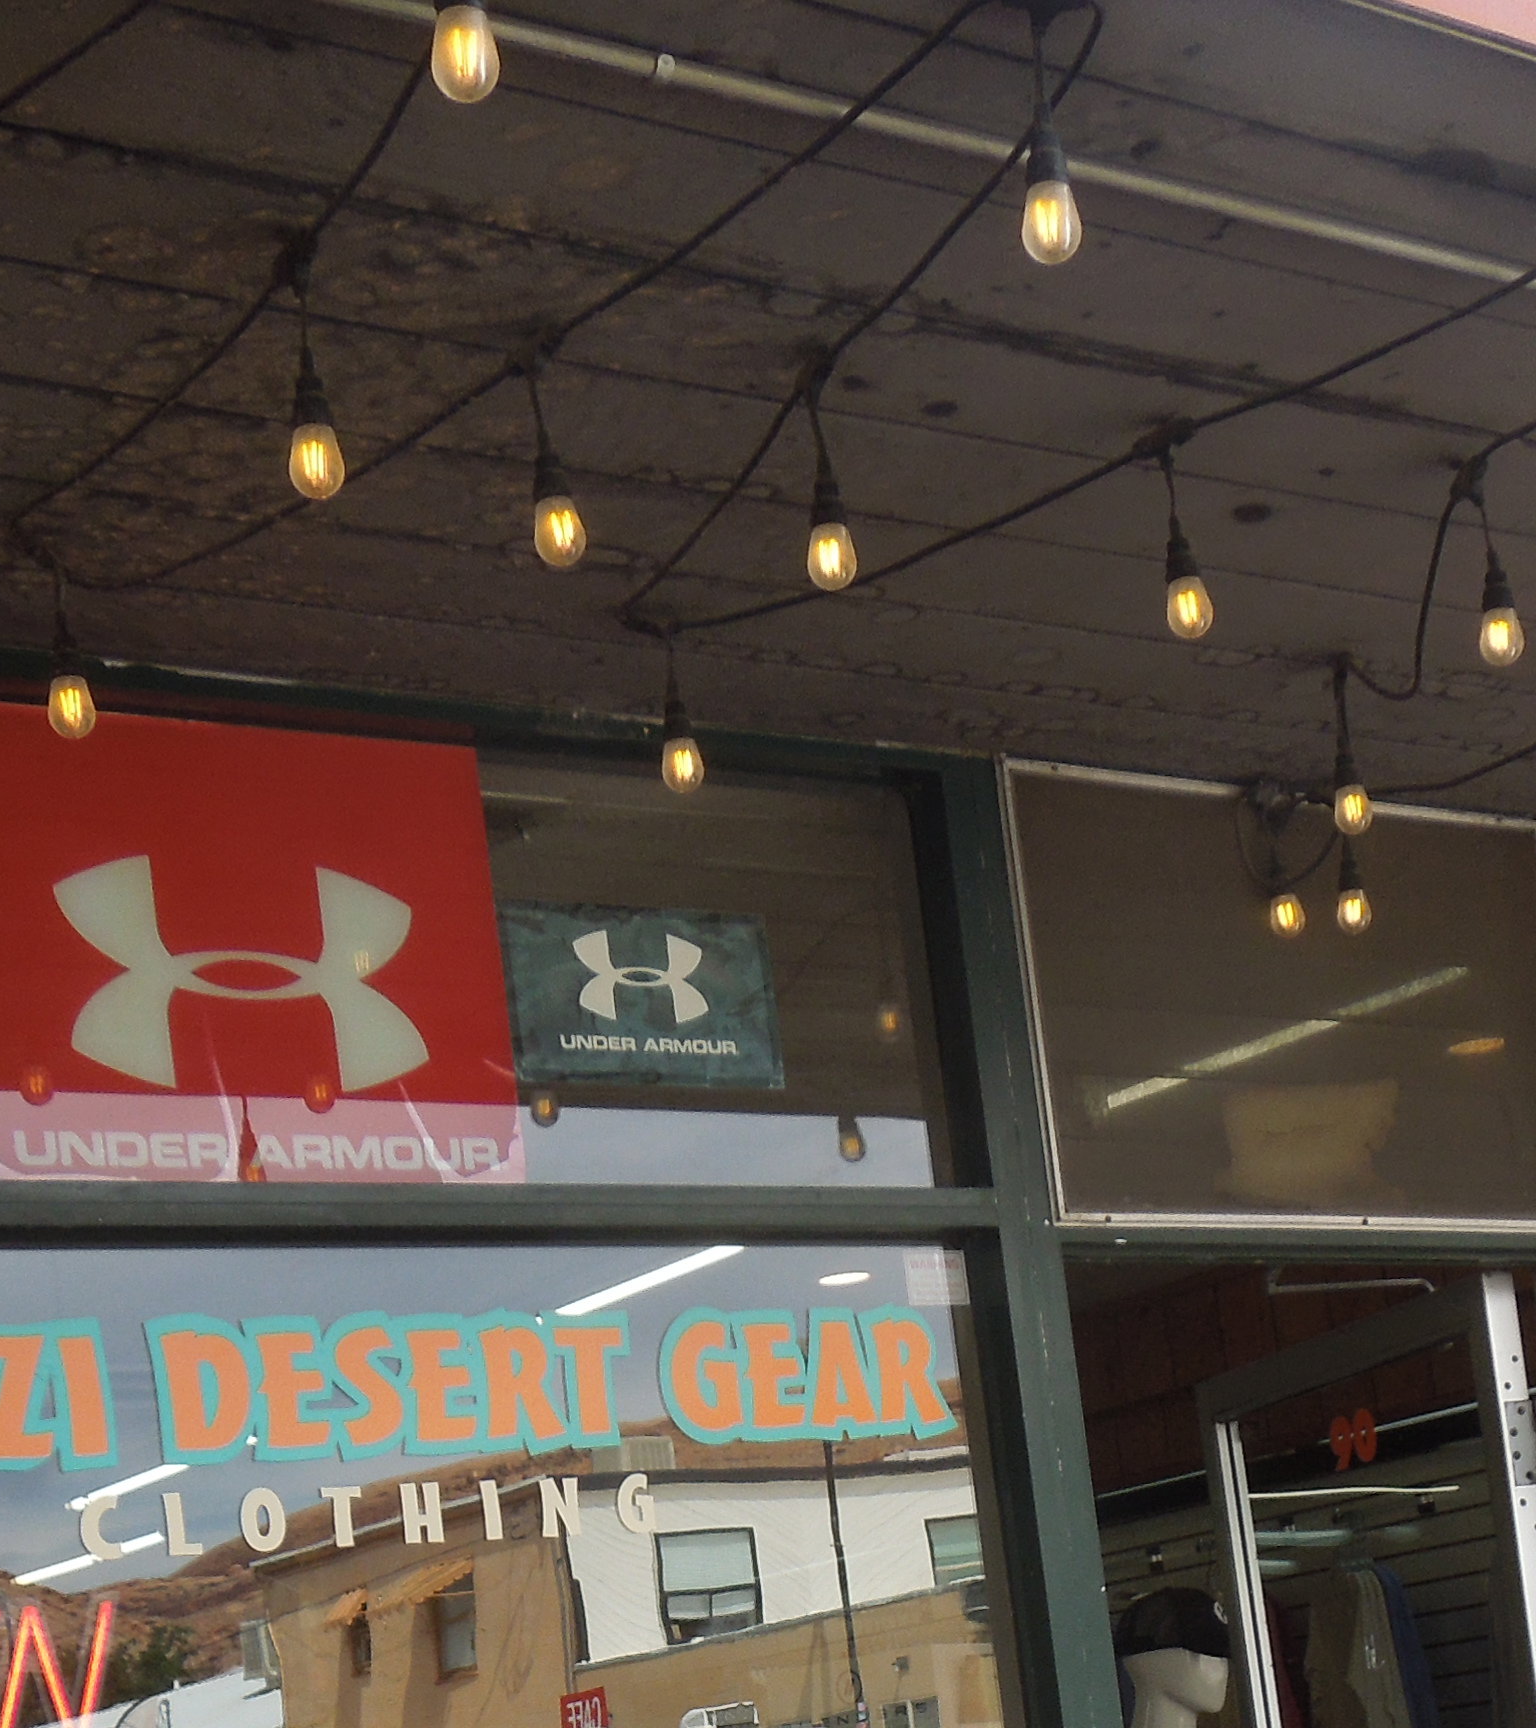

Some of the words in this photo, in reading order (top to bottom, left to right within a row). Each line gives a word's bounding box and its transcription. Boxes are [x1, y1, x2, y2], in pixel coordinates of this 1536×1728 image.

[559, 1031, 637, 1055] UNDER
[643, 1034, 738, 1058] ARMOUR
[12, 1129, 245, 1169] UNDER
[251, 1133, 501, 1174] ARMOUR
[144, 1307, 629, 1463] DESERT
[659, 1304, 958, 1446] GEAR
[80, 1471, 659, 1563] CLOTHING
